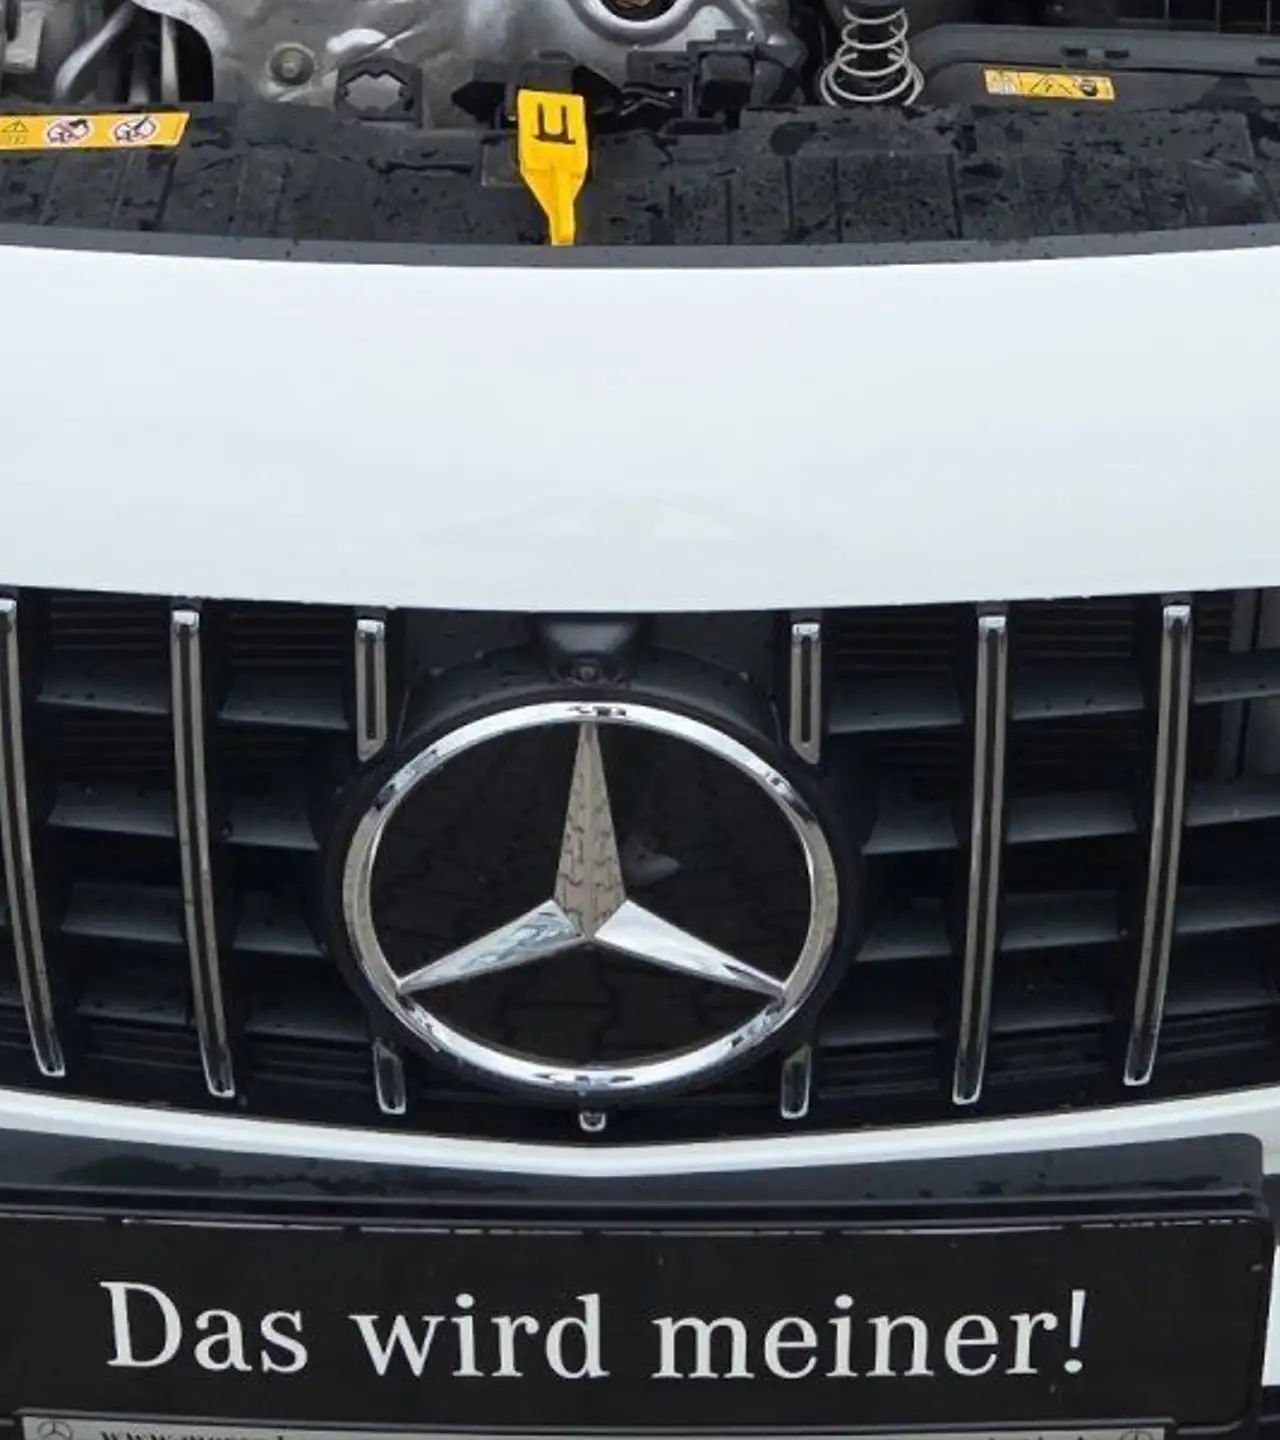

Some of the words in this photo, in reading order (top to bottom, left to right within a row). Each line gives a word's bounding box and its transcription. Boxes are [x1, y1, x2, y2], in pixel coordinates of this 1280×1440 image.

[98, 1280, 308, 1373] Das
[348, 1292, 609, 1379] wird
[652, 1289, 1086, 1379] meiner!
